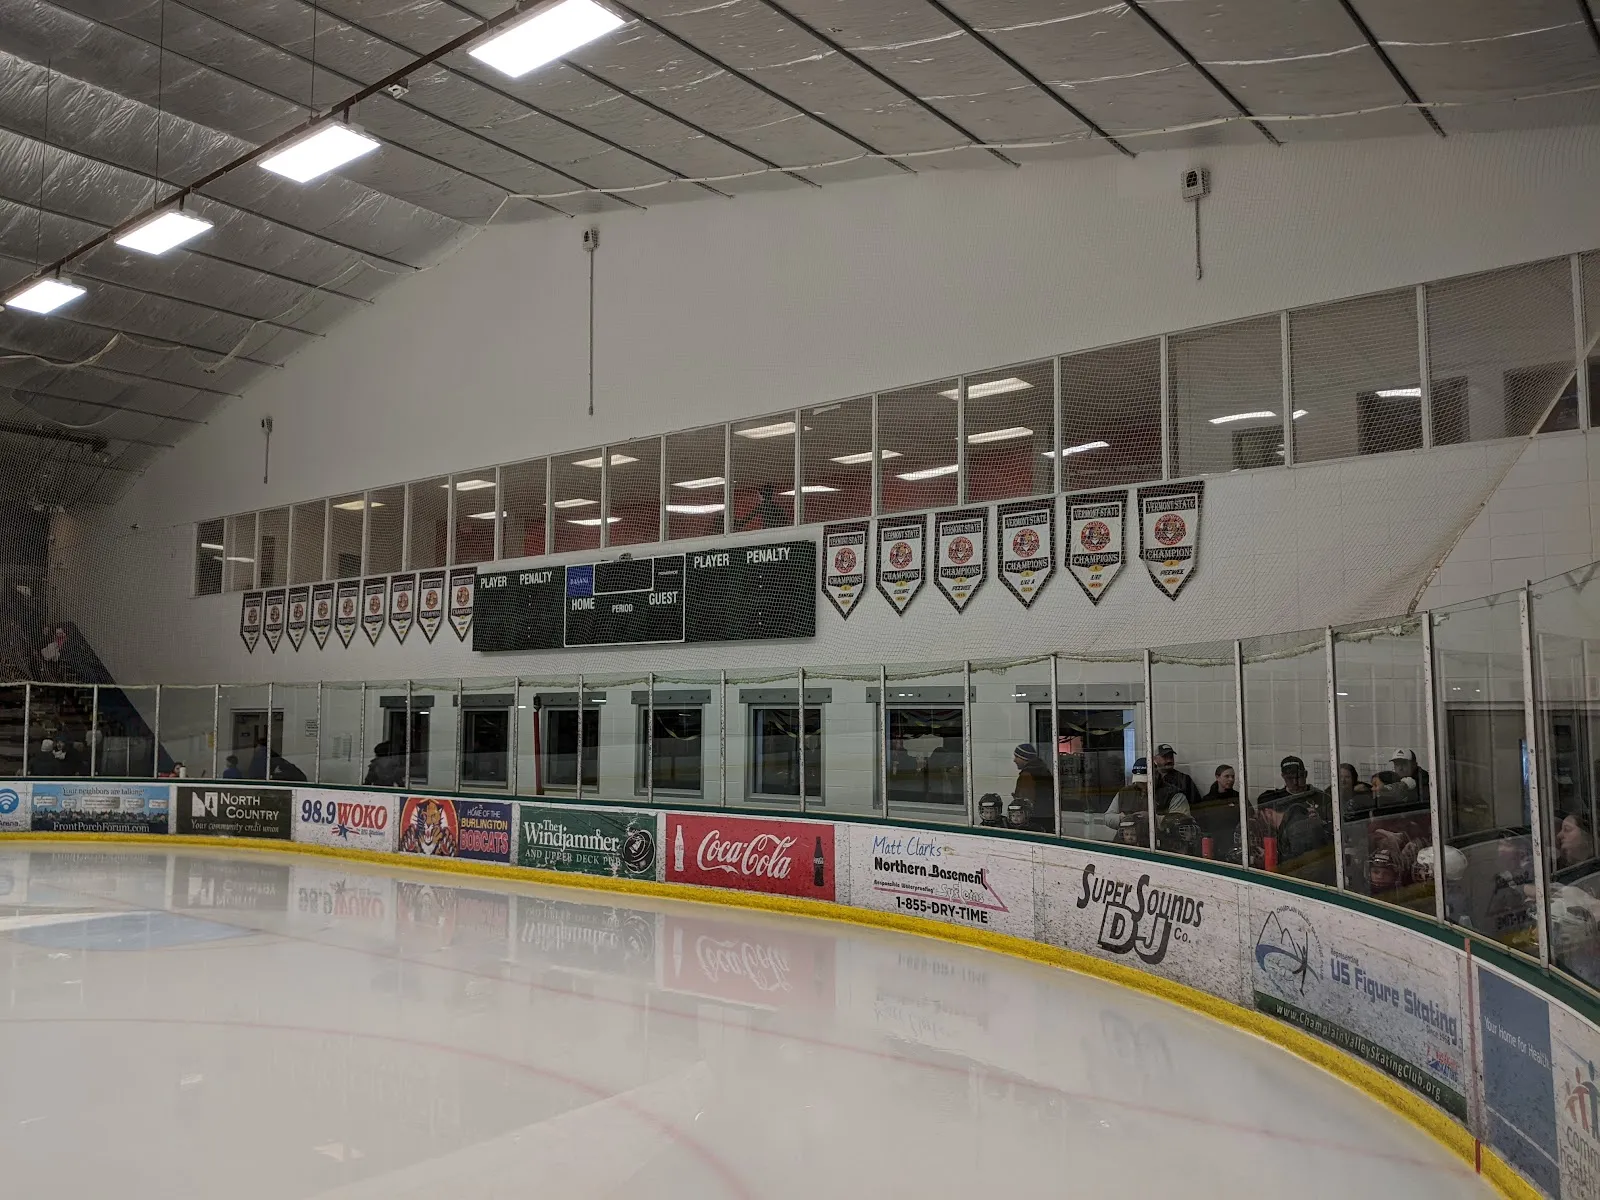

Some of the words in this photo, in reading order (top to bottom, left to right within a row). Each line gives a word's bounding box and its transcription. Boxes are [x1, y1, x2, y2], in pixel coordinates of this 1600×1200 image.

[1074, 508, 1099, 519] VERMONT
[1100, 506, 1120, 517] STATE
[1147, 502, 1173, 513] VERMONT
[1174, 500, 1196, 511] STATE
[964, 522, 982, 533] STATE
[1006, 517, 1029, 528] VERMONT
[1030, 514, 1048, 525] STATE
[694, 553, 730, 568] PLAYER
[747, 547, 791, 564] PENALTY
[1074, 554, 1120, 565] CHAMPIONS
[941, 566, 980, 577] CHAMPIONS
[1006, 560, 1049, 571] CHAMPIONS
[480, 576, 507, 589] PLAYER
[519, 571, 552, 586] PENALTY
[828, 575, 863, 586] CHAMPIONS
[883, 570, 919, 581] CHAMPIONS
[571, 598, 595, 611] HOME
[649, 591, 678, 605] GUEST
[612, 604, 633, 613] PERIOD
[63, 787, 77, 796] Your
[78, 788, 110, 797] neighbors
[220, 792, 261, 806] NORTH
[226, 806, 280, 820] COUNTRY
[301, 799, 337, 825] 98.9
[337, 802, 388, 830] WOKO
[467, 809, 482, 817] HOME
[490, 810, 501, 818] THE
[53, 822, 150, 833] FrontPorchForum.com
[191, 818, 206, 830] Your
[208, 822, 243, 832] community
[245, 822, 261, 832] credit
[461, 818, 508, 830] BURLINGTON
[543, 819, 558, 831] The
[460, 829, 509, 855] BOBCATS
[524, 821, 620, 852] Windjammer
[872, 835, 902, 855] Matt
[906, 836, 942, 857] Clark's
[525, 849, 542, 858] AND
[545, 851, 573, 862] UPPER
[576, 854, 600, 865] DECK
[697, 829, 798, 880] Coca-Cola
[874, 856, 927, 877] Northern
[928, 865, 988, 890] Basement
[1076, 863, 1133, 909] SUPER
[1132, 874, 1204, 928] SOUNDS
[896, 896, 989, 924] 1-855-DRY-TIME
[1097, 901, 1173, 965] DJ
[1174, 927, 1192, 944] Co.
[1330, 958, 1349, 985] US
[1355, 966, 1400, 1008] Figure
[1403, 987, 1458, 1046] Skating
[1484, 1015, 1497, 1035] Your
[1499, 1024, 1517, 1047] Home
[1518, 1036, 1527, 1053] for
[1276, 1003, 1441, 1101] www.ChamplainValleySkatingClub.org
